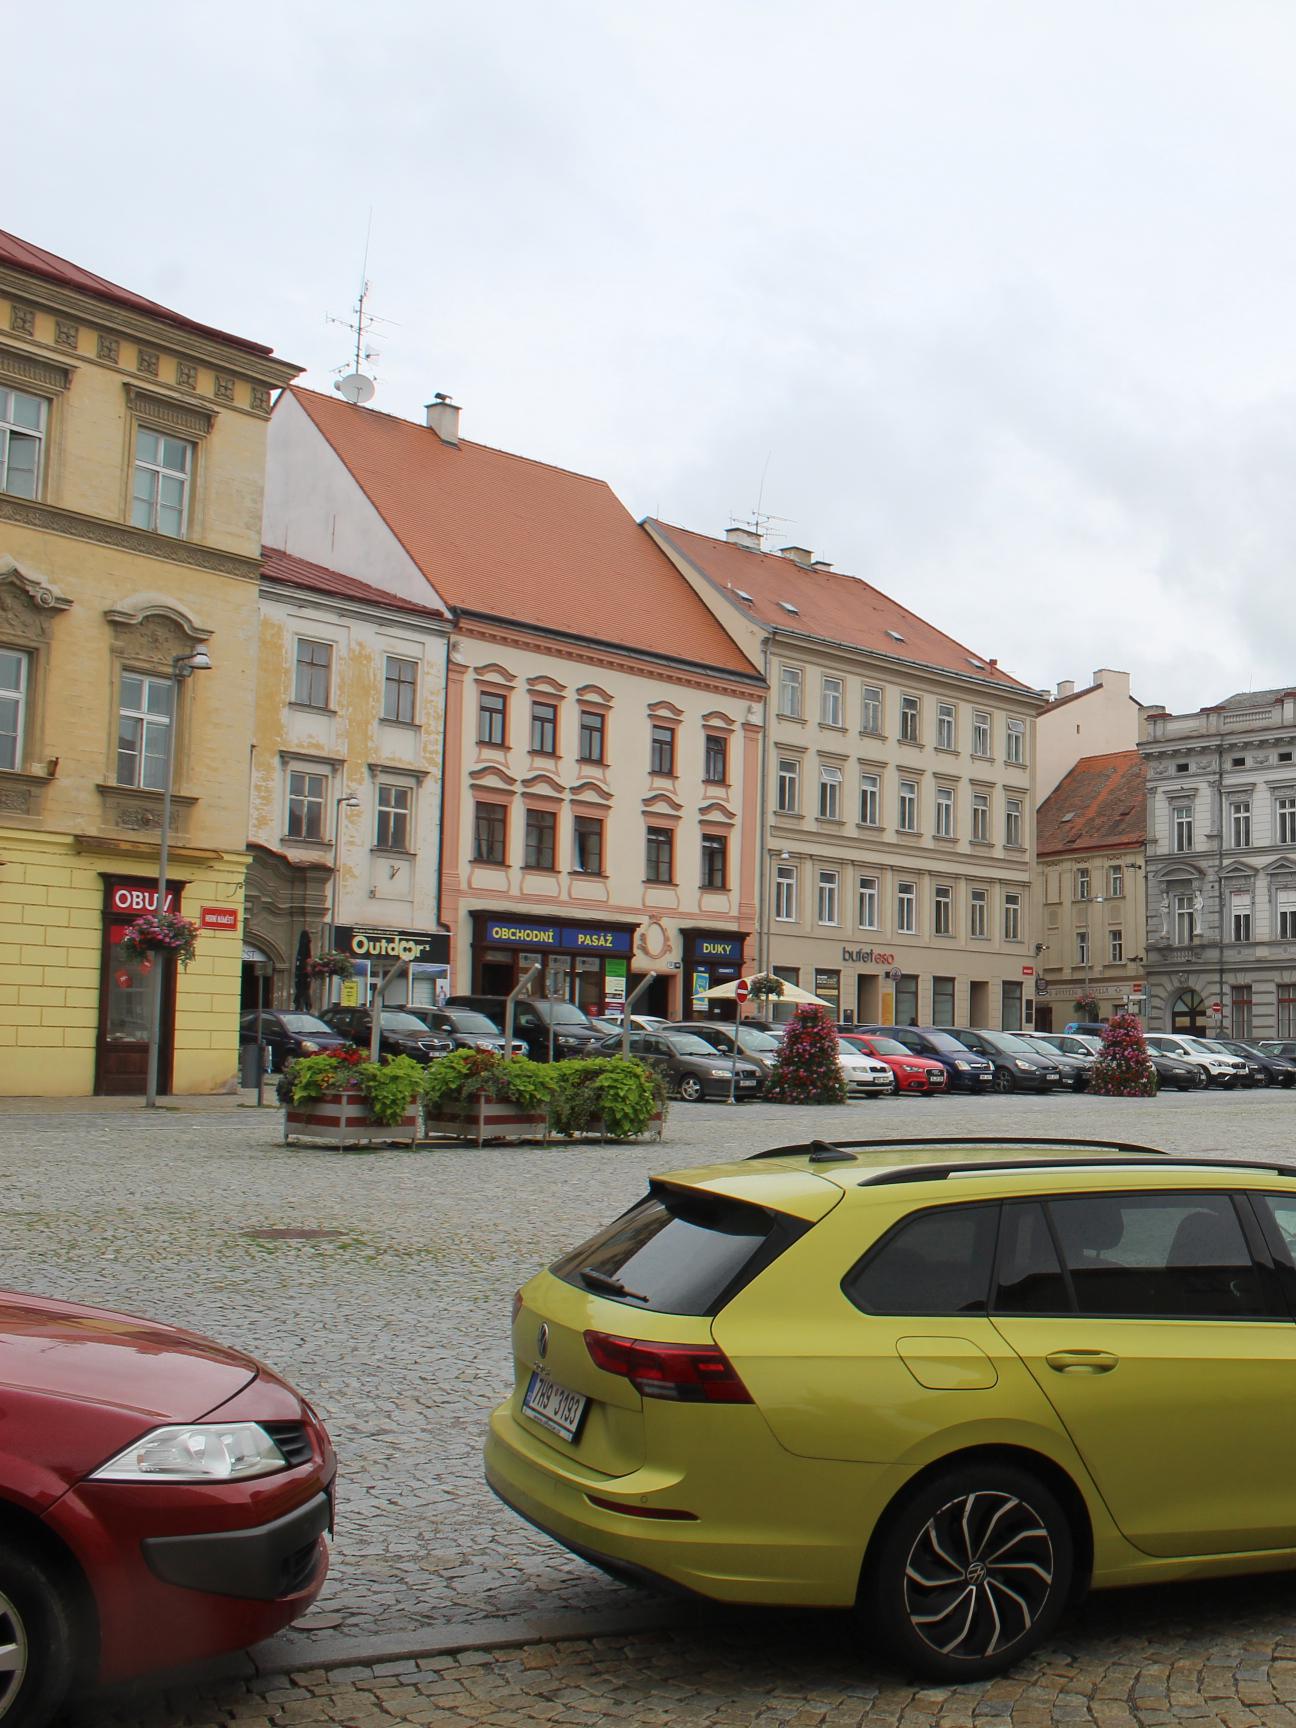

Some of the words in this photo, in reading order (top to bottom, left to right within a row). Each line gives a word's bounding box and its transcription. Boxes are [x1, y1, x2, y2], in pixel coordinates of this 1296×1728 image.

[492, 927, 554, 943] OBCHODNÍ
[578, 933, 613, 947] PASÁŽ
[703, 943, 732, 955] DUKY
